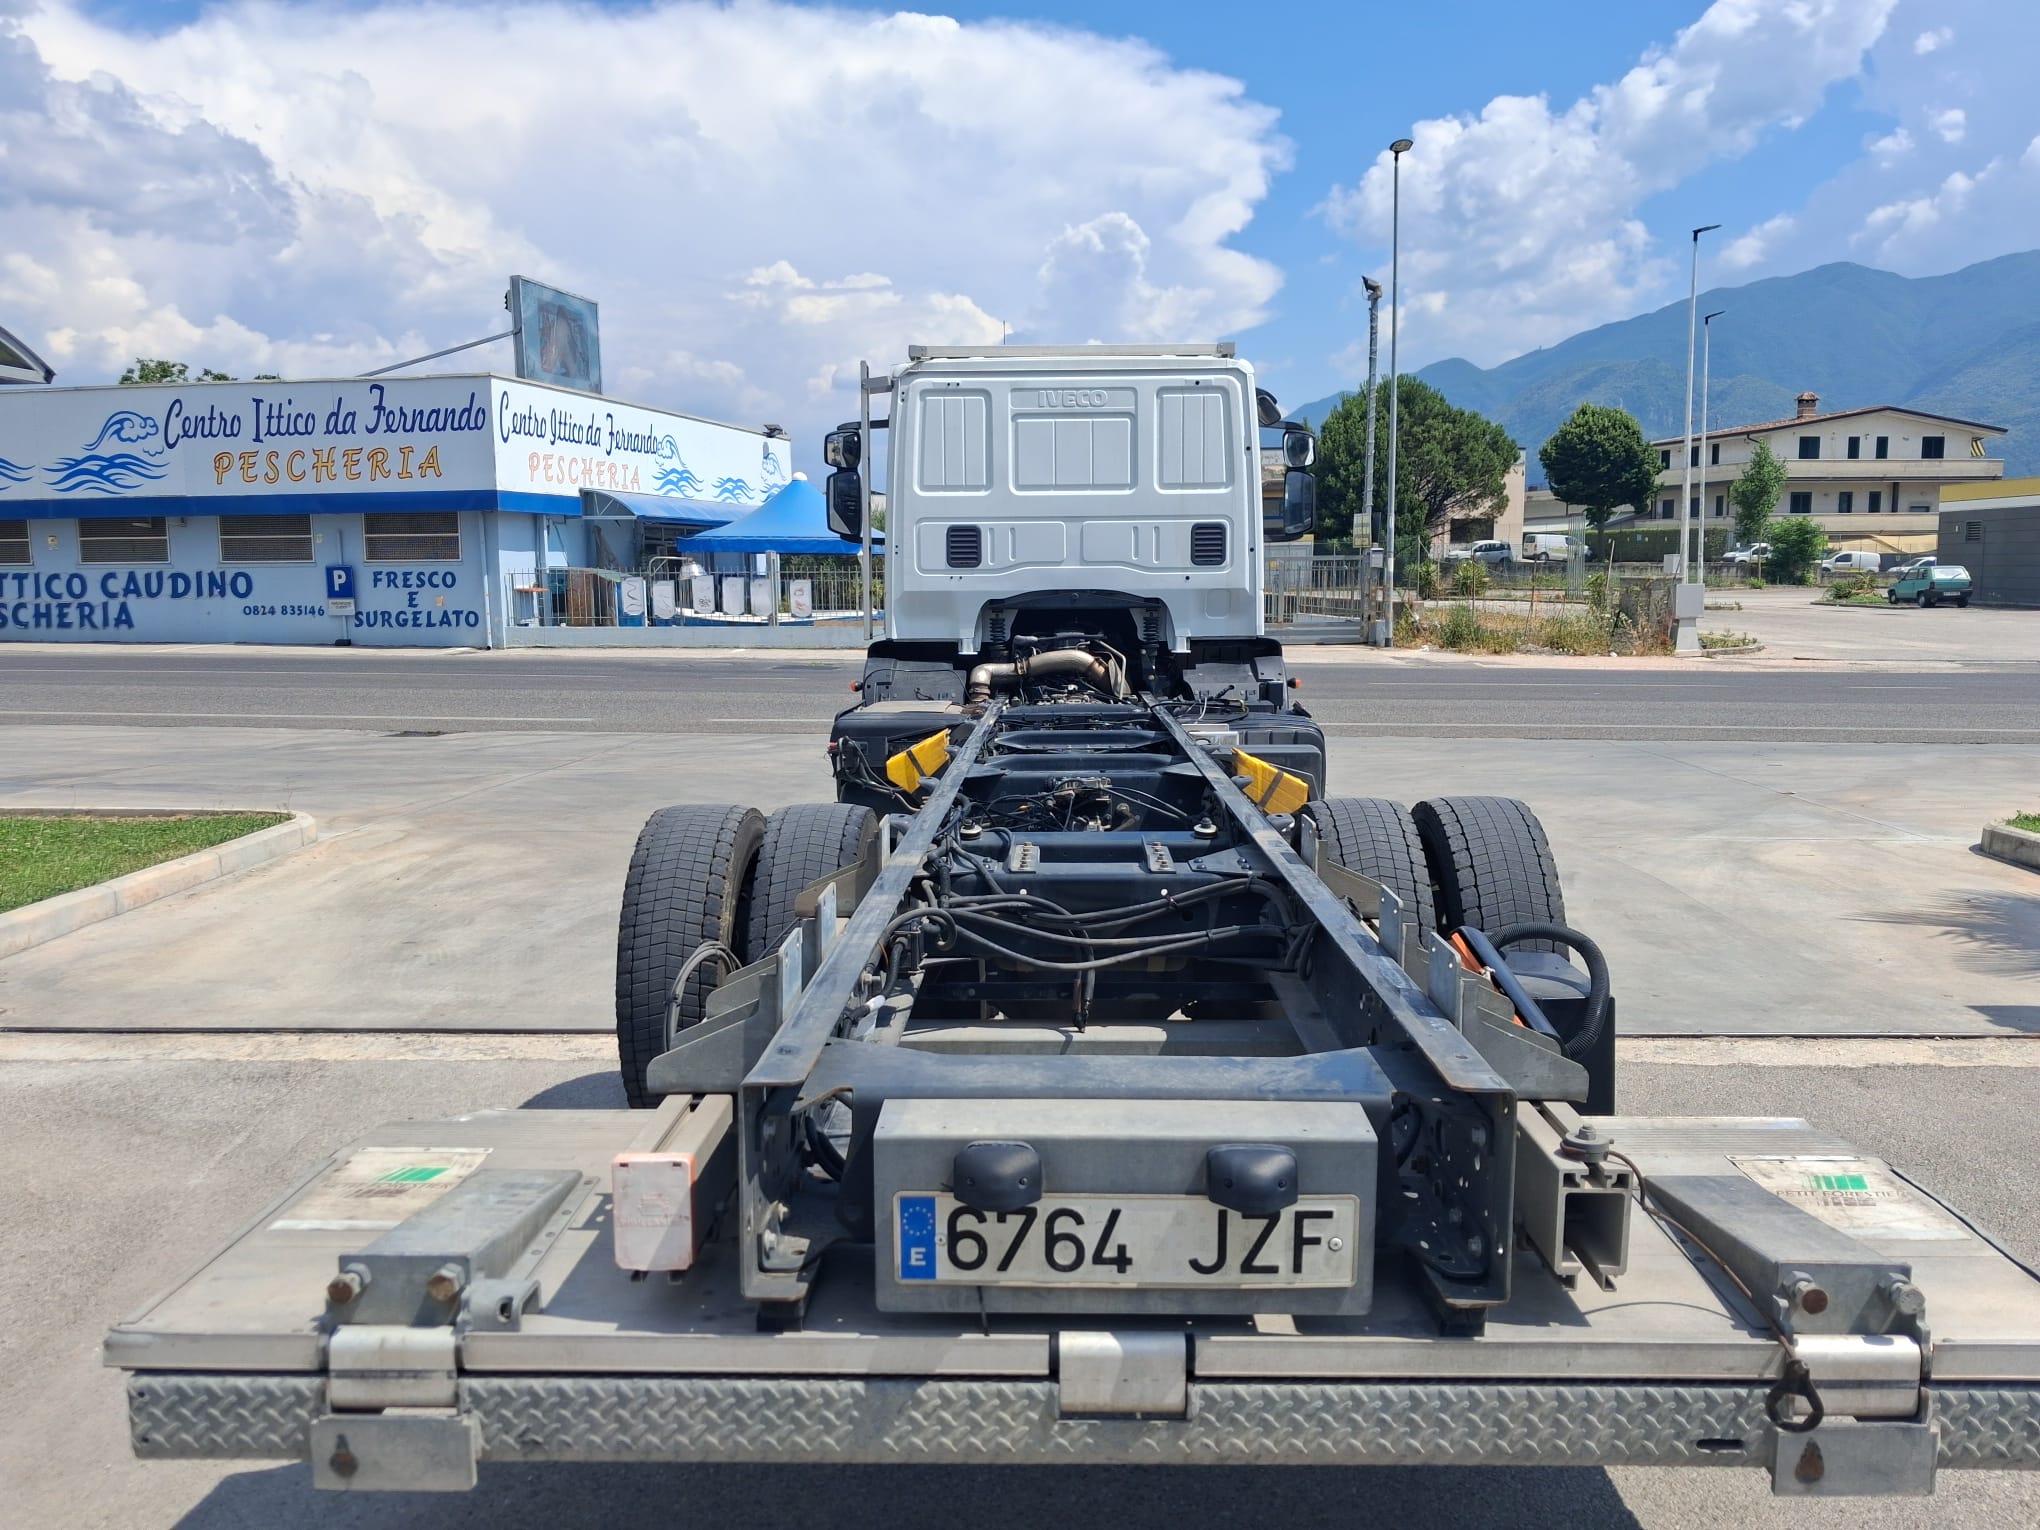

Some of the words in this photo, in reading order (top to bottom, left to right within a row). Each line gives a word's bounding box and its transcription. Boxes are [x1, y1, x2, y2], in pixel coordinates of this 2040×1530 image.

[1037, 389, 1108, 408] IVECO
[163, 398, 242, 450] Centro
[251, 397, 316, 443] Ittico
[323, 396, 357, 435] da
[364, 383, 487, 434] Fernando
[499, 390, 547, 443] Centro
[549, 407, 584, 446] Ittico
[586, 412, 602, 447] da
[605, 412, 659, 456] Fernando
[213, 445, 443, 486] PESCHERIA
[528, 451, 641, 491] PESCHERIA
[100, 570, 254, 599] CAUDINO
[332, 569, 347, 592] P
[372, 570, 457, 589] FRESCO
[243, 605, 276, 616] 0824
[281, 605, 325, 617] 835146
[407, 591, 419, 608] E
[353, 609, 480, 628] SURGELATO
[909, 1247, 927, 1266] E
[946, 1206, 1133, 1274] 6764
[1188, 1209, 1334, 1275] JZF
